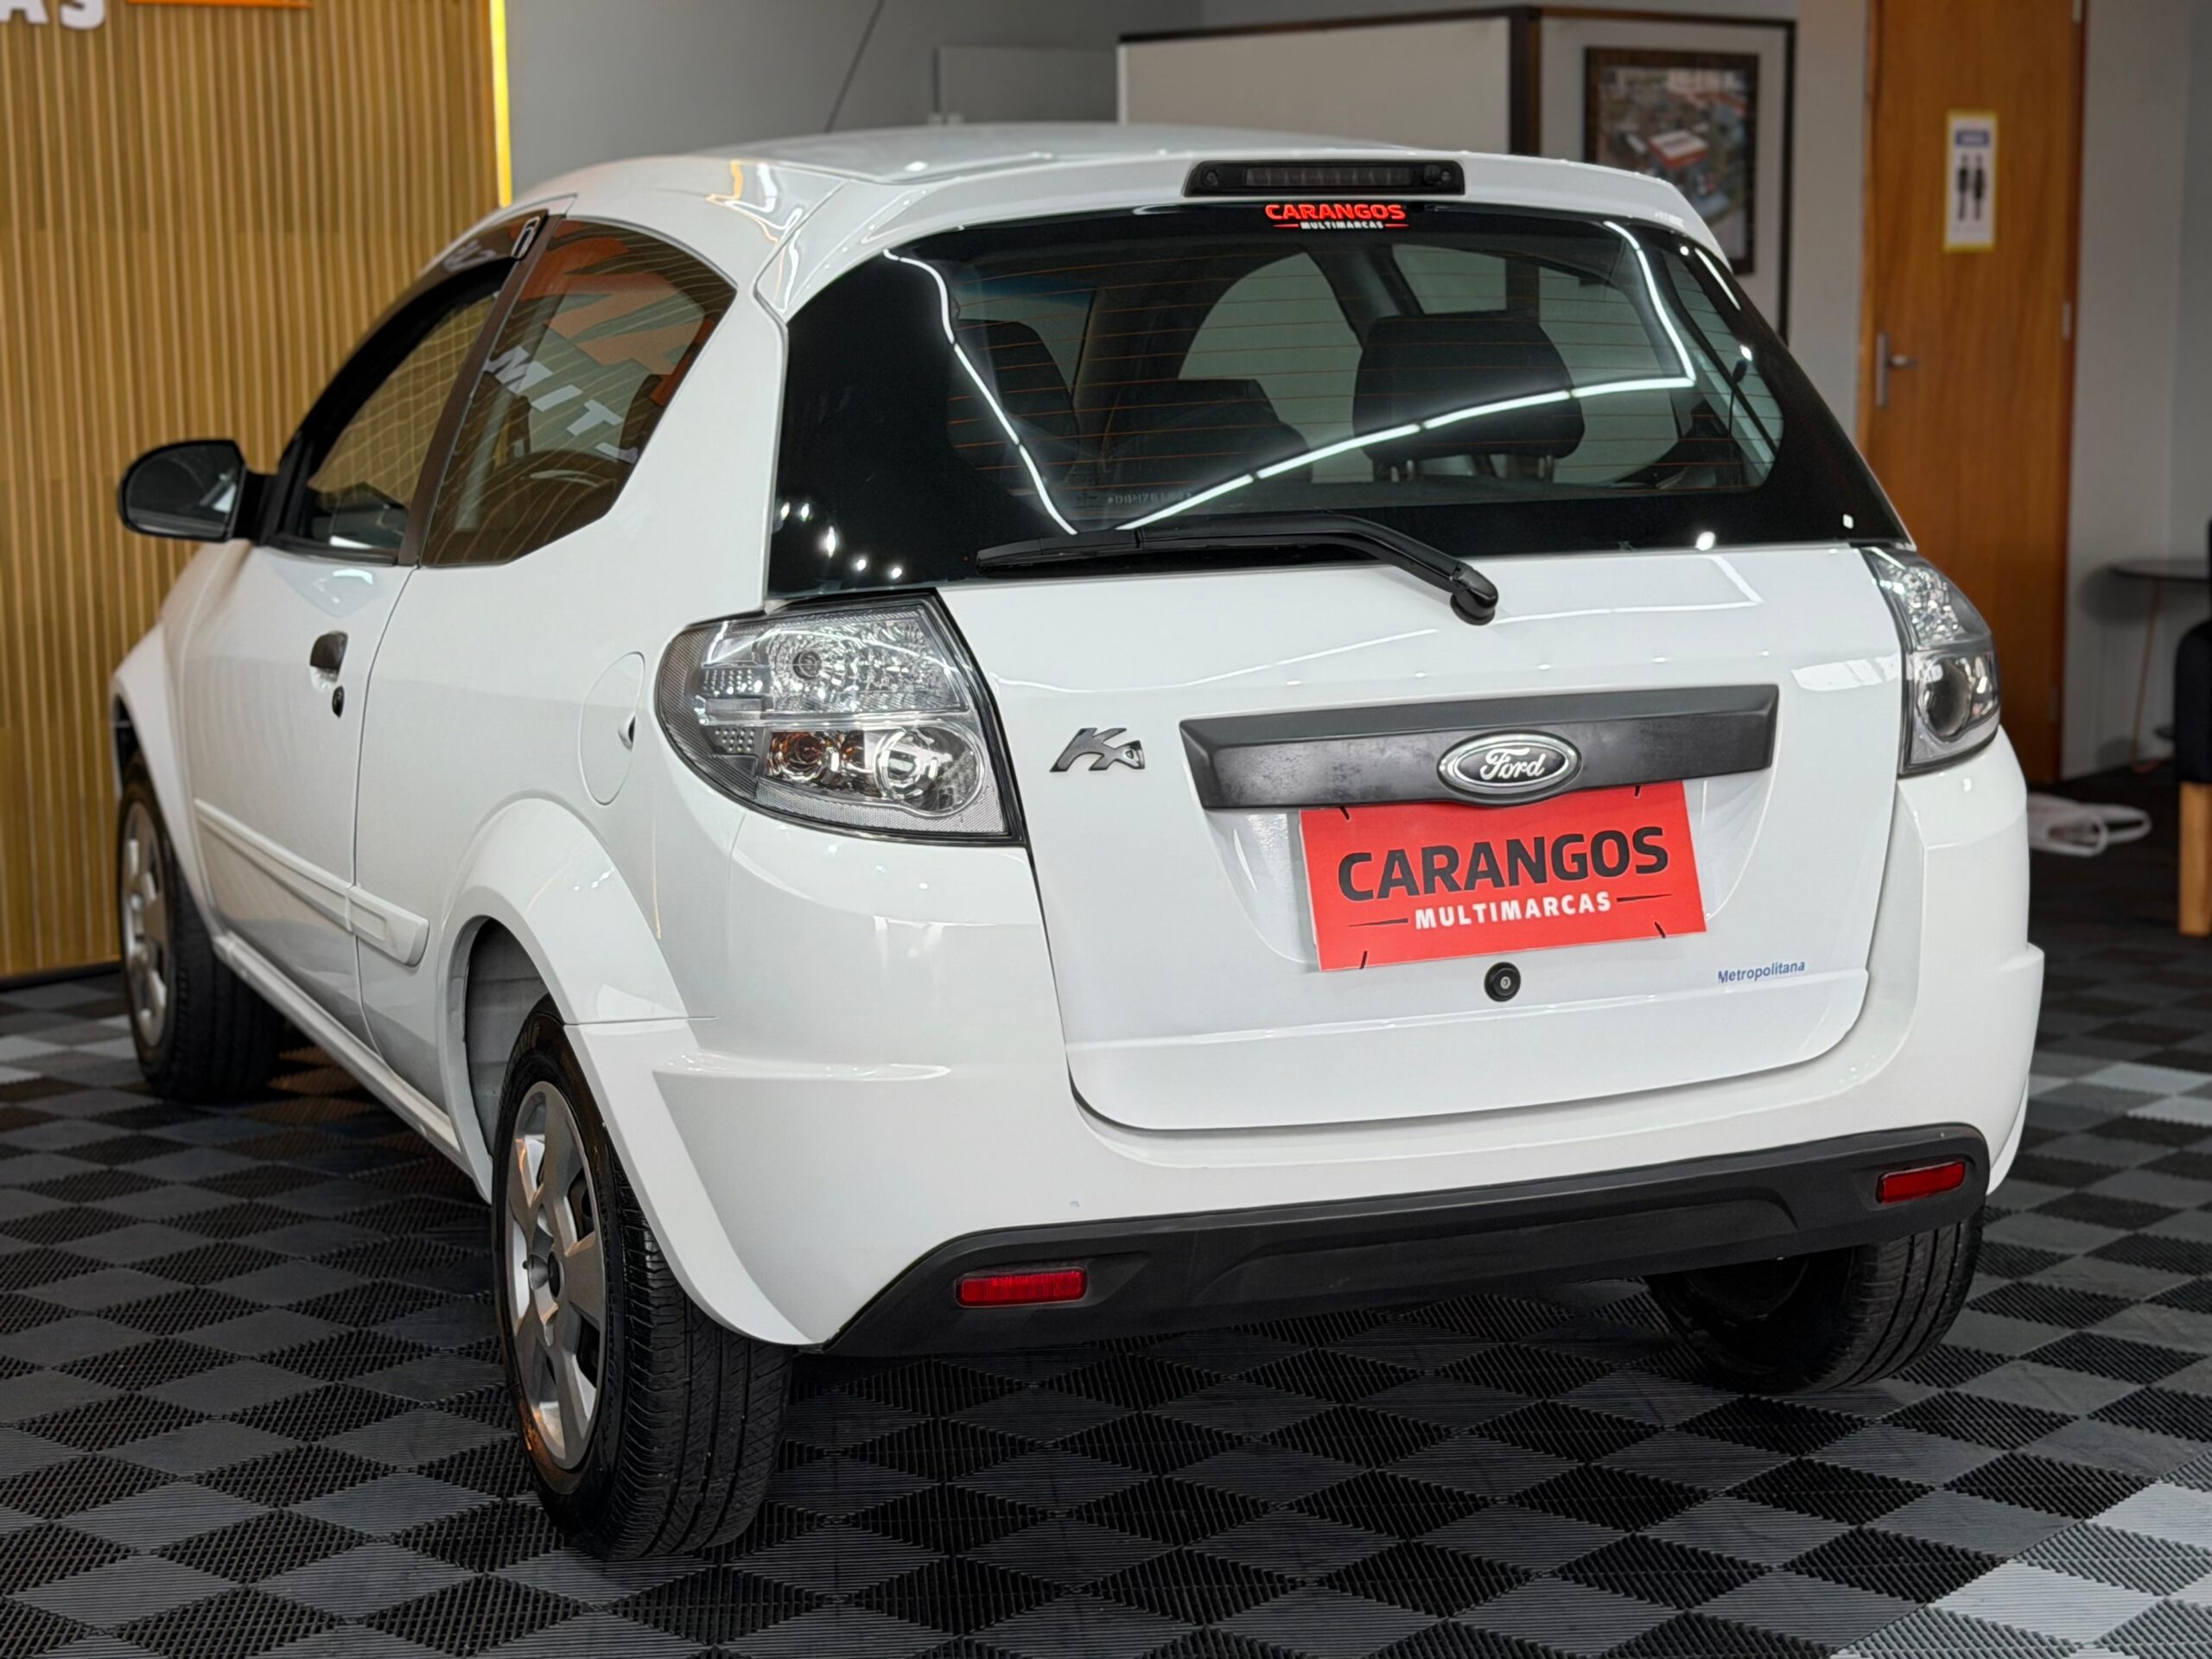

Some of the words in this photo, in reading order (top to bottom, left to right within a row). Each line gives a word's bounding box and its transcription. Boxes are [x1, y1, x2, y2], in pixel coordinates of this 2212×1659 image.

[1266, 204, 1406, 219] CARANGOS
[1300, 221, 1384, 230] MULTIMARCAS
[1479, 747, 1546, 780] Ford
[1338, 826, 1669, 901] CARANGOS
[1415, 891, 1612, 930] MULTIMARCAS
[1718, 961, 1805, 983] Metropolitana
